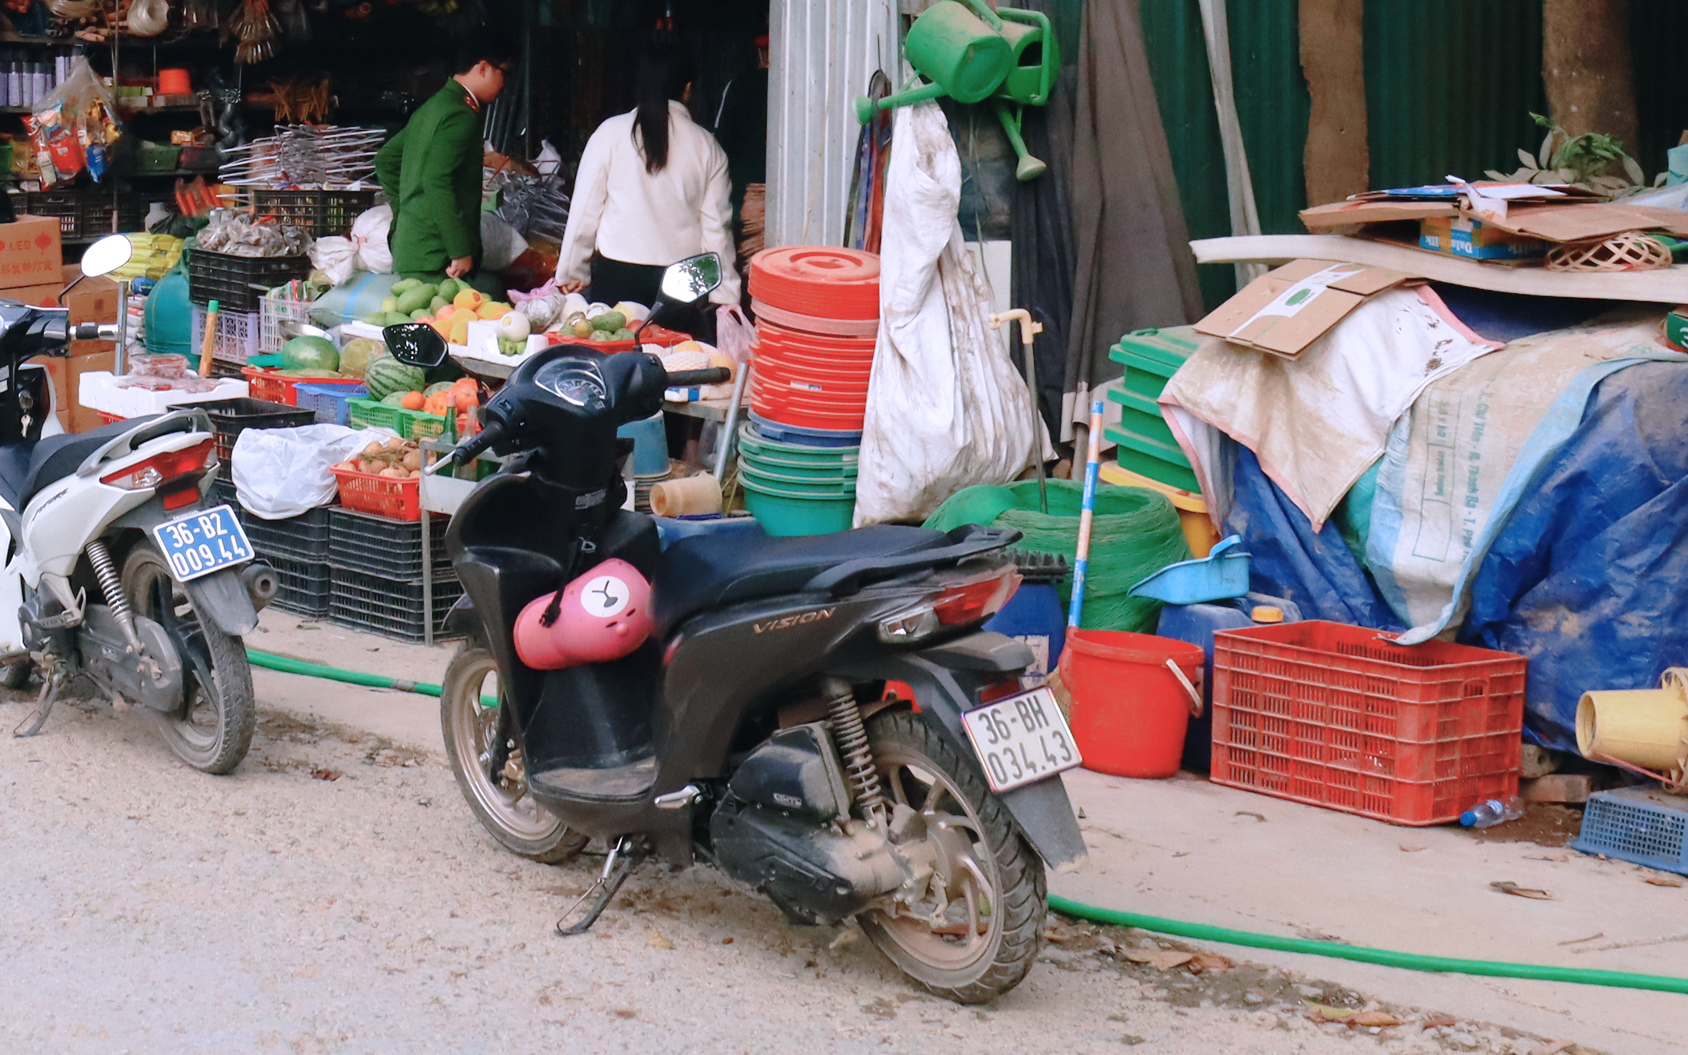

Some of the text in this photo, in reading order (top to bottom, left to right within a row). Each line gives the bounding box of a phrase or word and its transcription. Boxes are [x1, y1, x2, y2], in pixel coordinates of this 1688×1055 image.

[9, 239, 32, 252] LED
[166, 512, 228, 549] 36-B2
[172, 534, 247, 576] 009.44
[753, 606, 837, 634] VISION
[978, 695, 1050, 745] 36-BH
[987, 730, 1073, 785] 034.43
